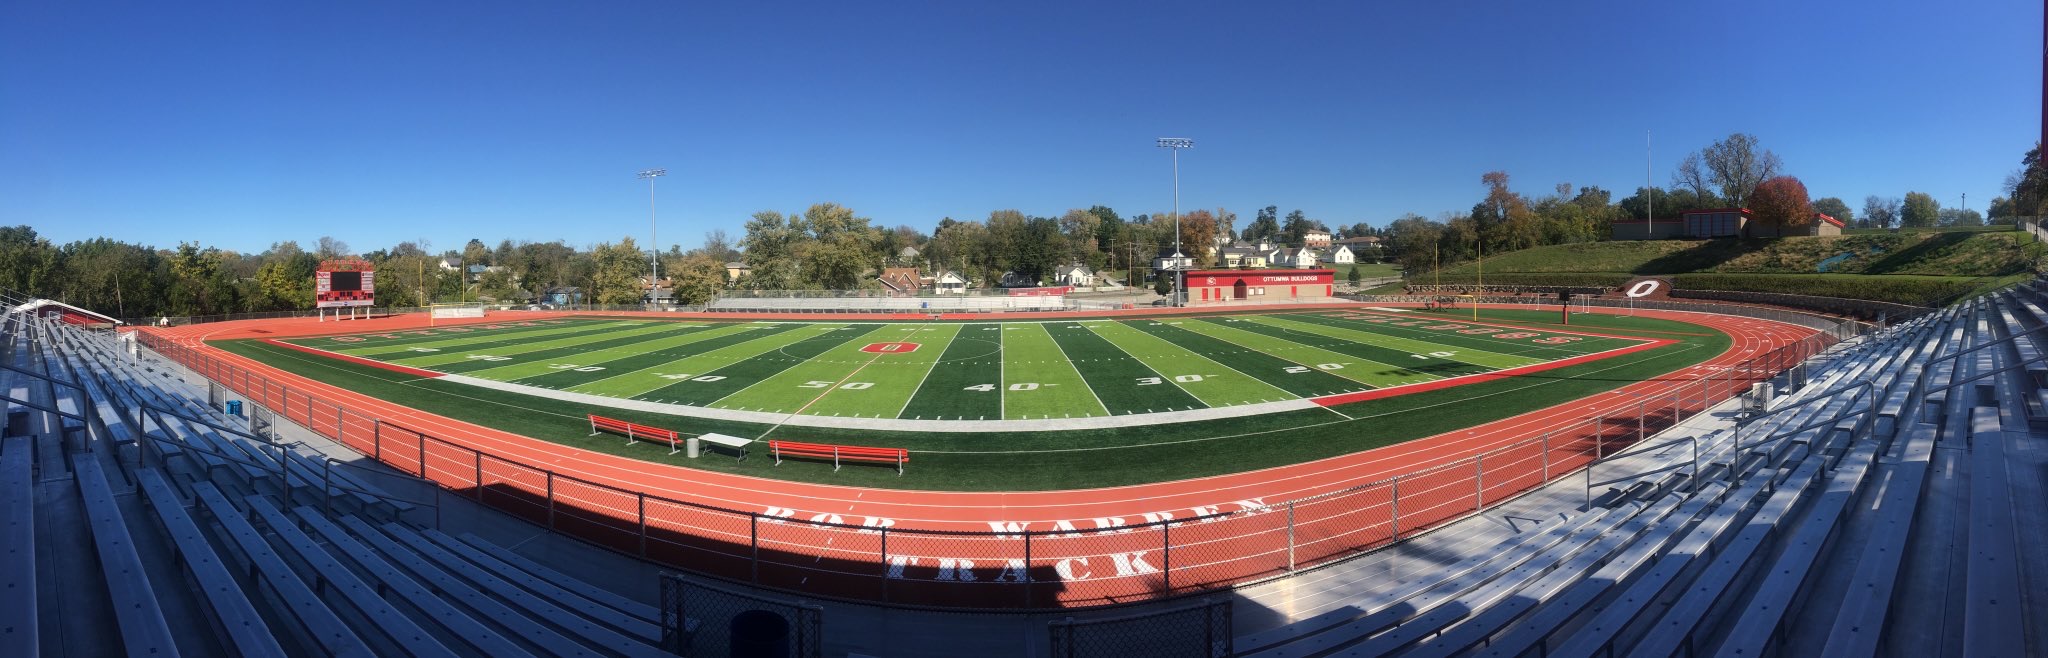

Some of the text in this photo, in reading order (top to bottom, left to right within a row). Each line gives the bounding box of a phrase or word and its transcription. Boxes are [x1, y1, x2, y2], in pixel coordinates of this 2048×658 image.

[1282, 362, 1344, 374] 20
[797, 380, 875, 390] 50
[1135, 374, 1203, 386] 30
[963, 382, 1039, 392] 40
[885, 550, 1160, 583] TRACK
